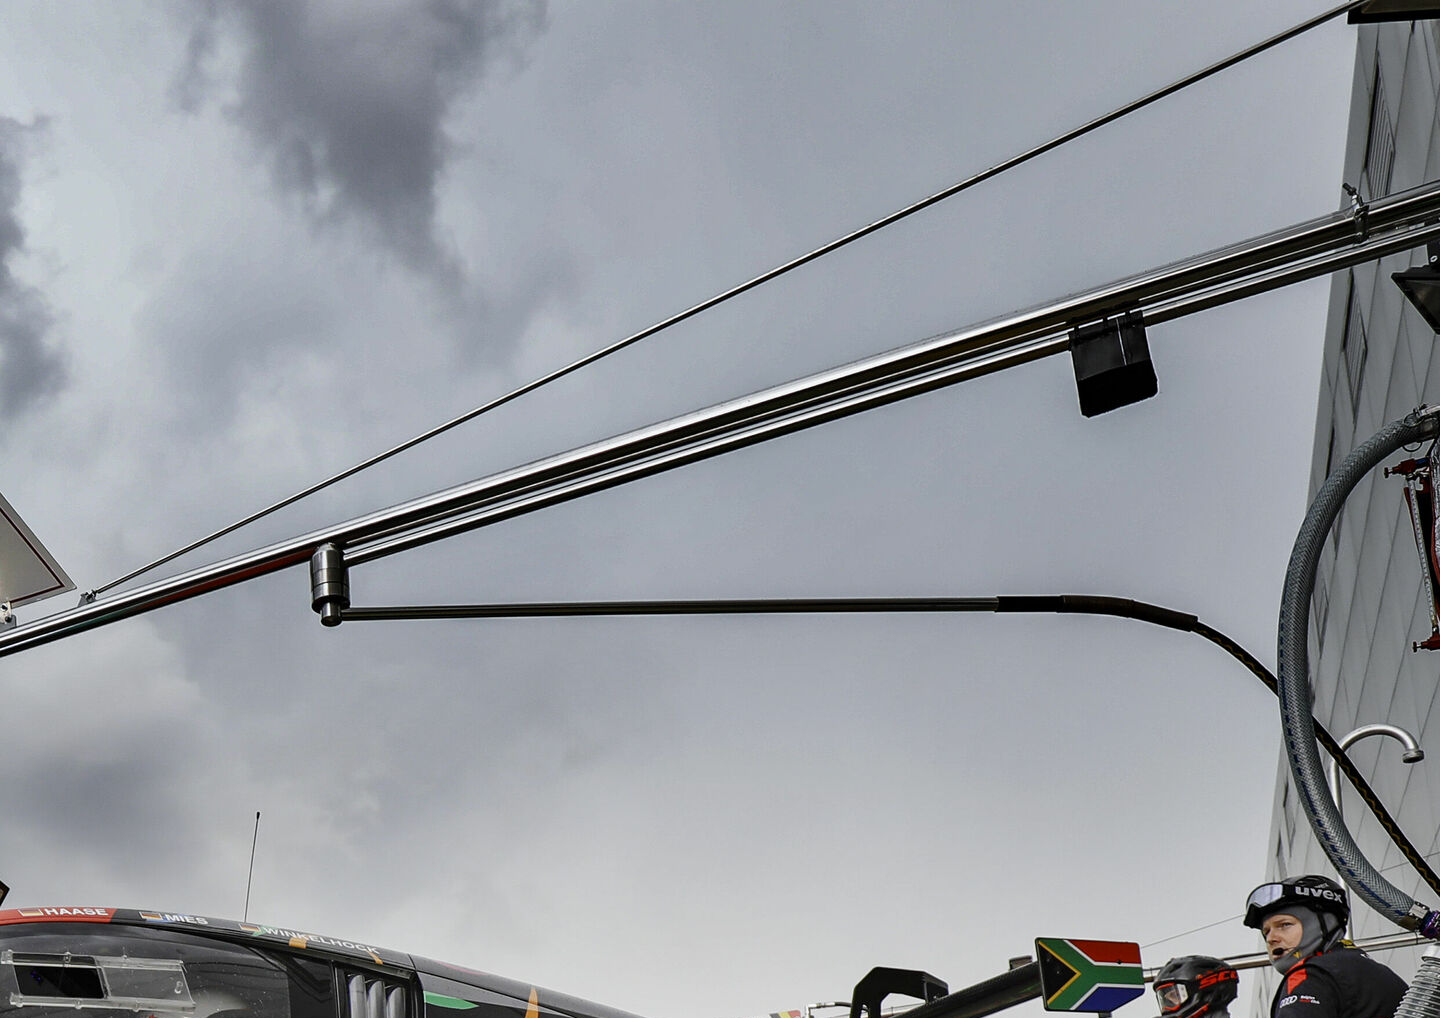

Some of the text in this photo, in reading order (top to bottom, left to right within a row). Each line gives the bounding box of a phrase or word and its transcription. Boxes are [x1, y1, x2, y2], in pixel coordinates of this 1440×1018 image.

[1295, 885, 1343, 903] uvex
[44, 908, 381, 955] HAASE MIES WINKELHOCK
